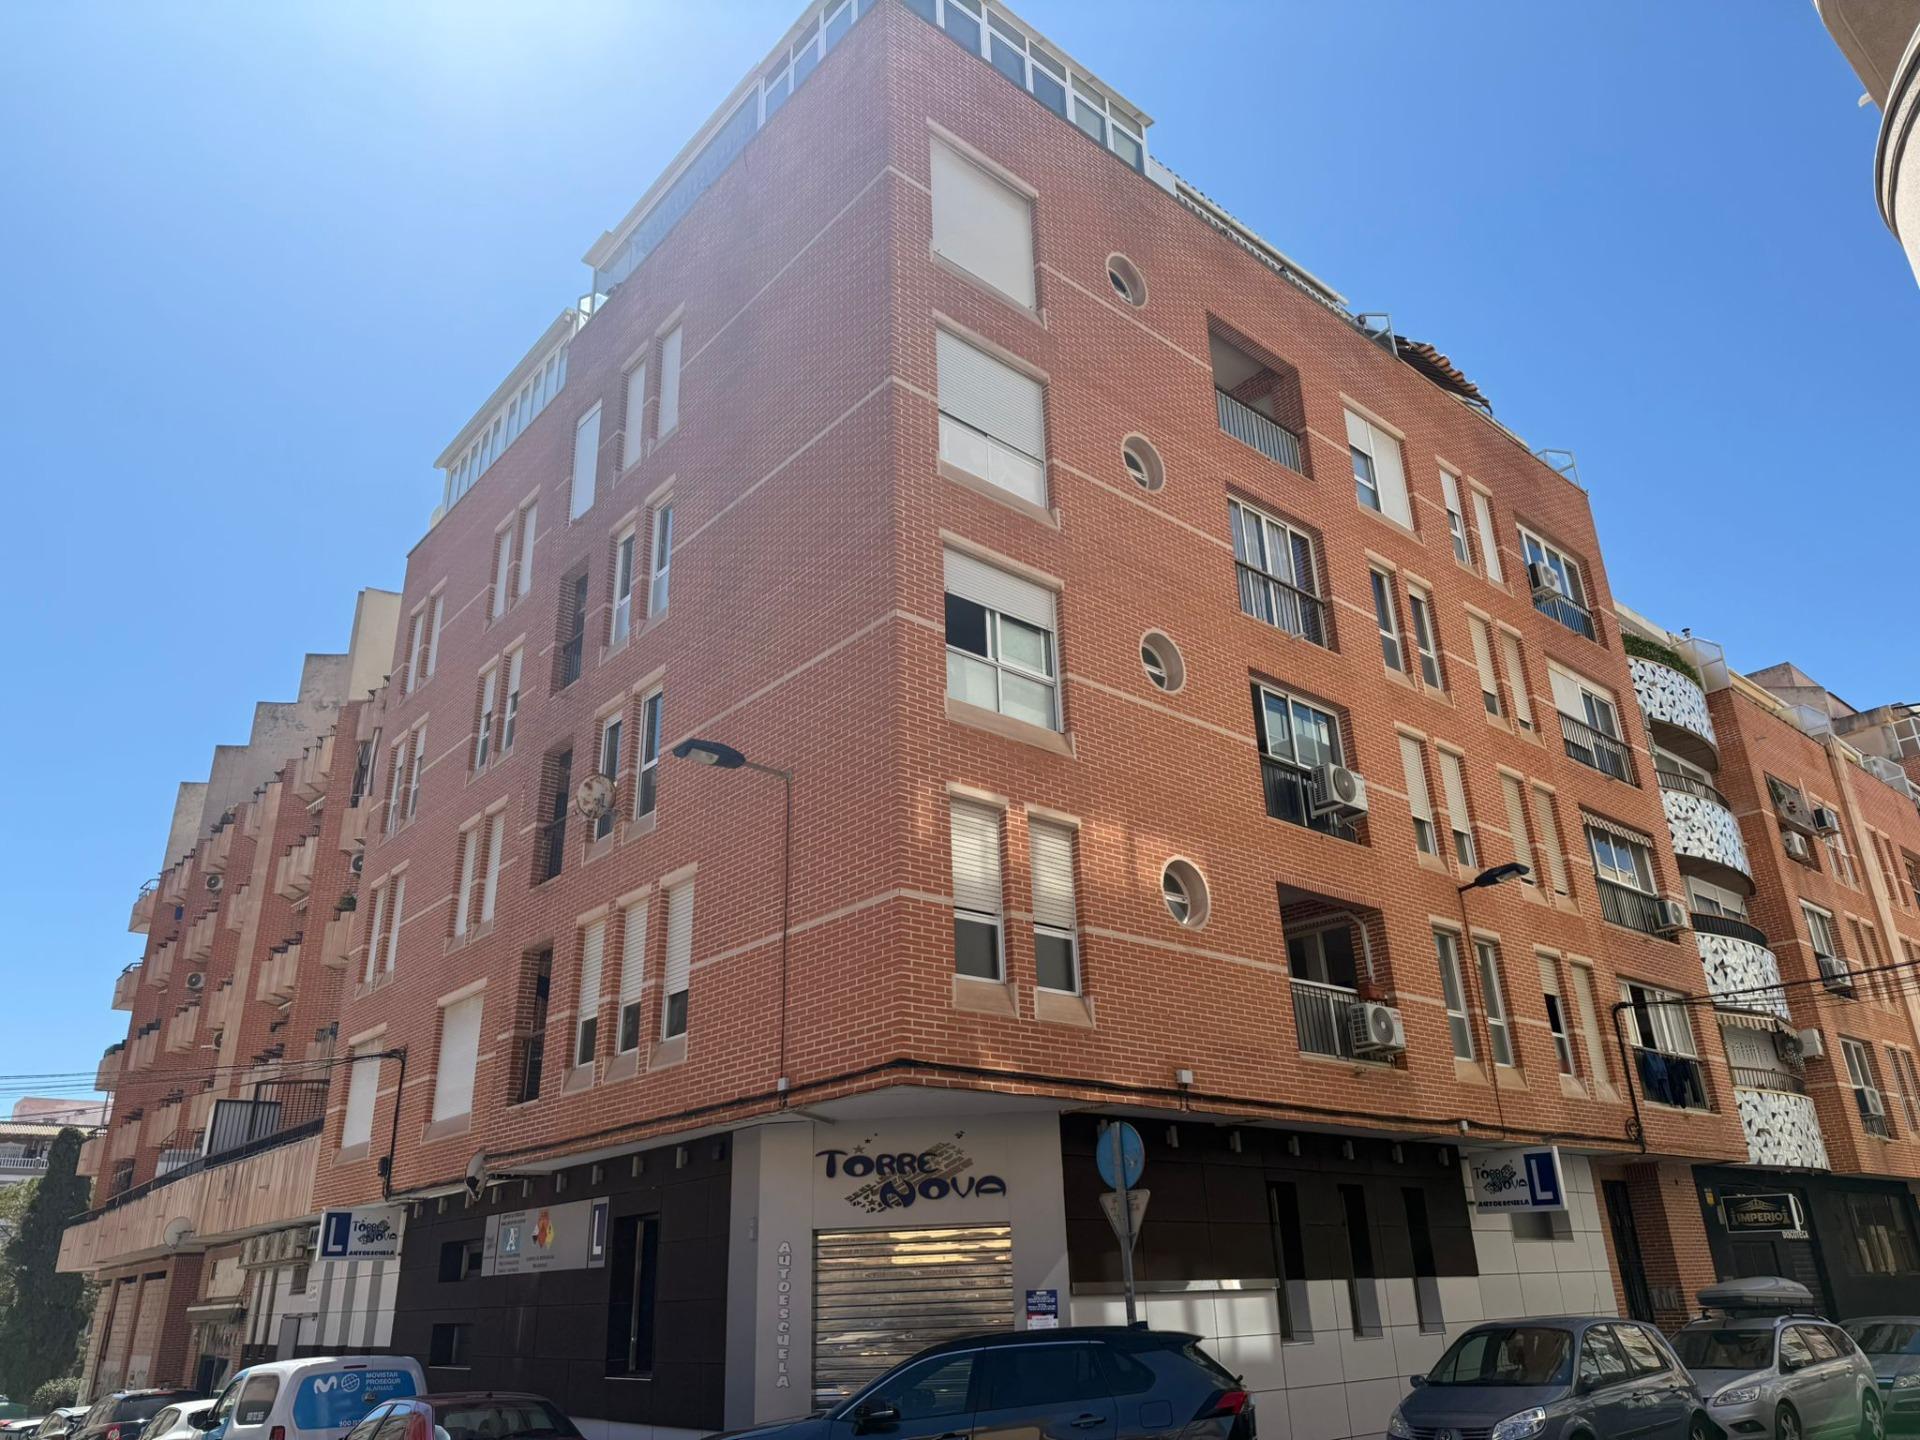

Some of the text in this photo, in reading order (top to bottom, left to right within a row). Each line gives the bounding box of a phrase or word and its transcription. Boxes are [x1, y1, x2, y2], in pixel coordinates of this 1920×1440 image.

[815, 1149, 940, 1178] TORRE
[1530, 1159, 1554, 1200] L
[879, 1174, 1007, 1208] NOVA
[327, 1217, 343, 1252] L
[1736, 1212, 1783, 1223] IMPERIO
[776, 1241, 792, 1388] AUTOESCUELA
